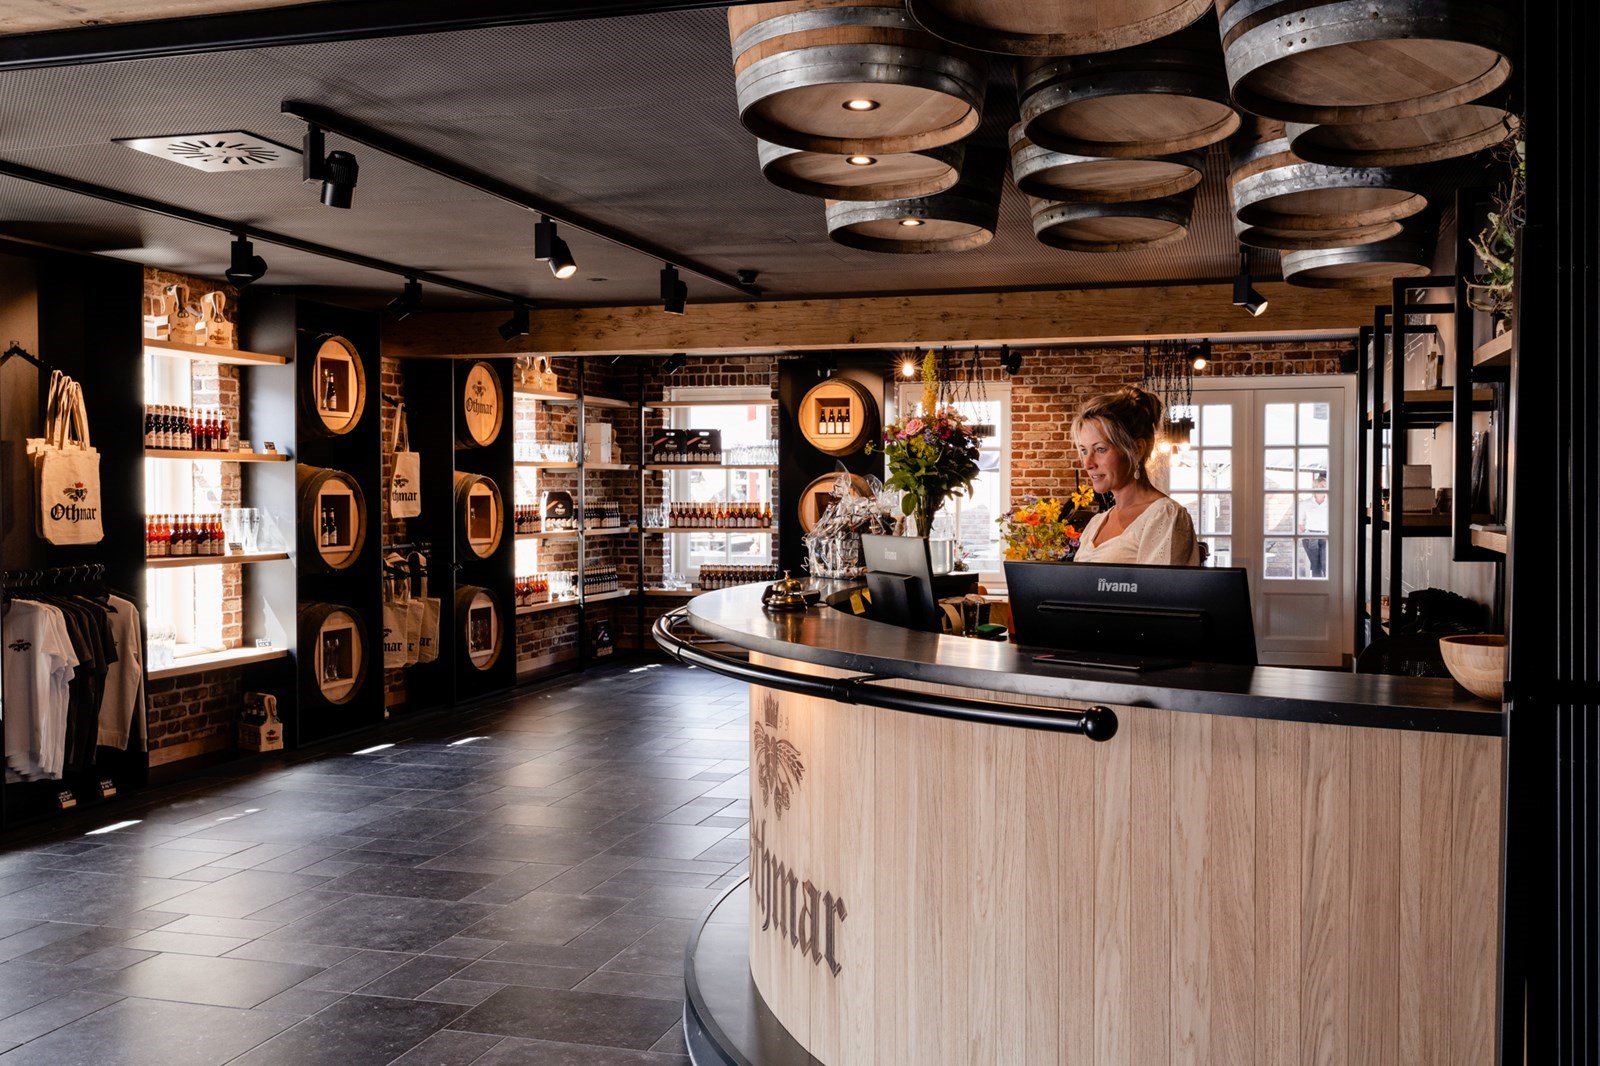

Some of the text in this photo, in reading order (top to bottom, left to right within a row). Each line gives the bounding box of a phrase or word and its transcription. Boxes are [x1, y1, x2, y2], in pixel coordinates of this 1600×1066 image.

[465, 397, 493, 416] Othmar
[391, 490, 418, 503] thmar
[50, 503, 97, 523] Othmar
[1097, 577, 1138, 593] iiyama
[749, 796, 848, 978] thmar
